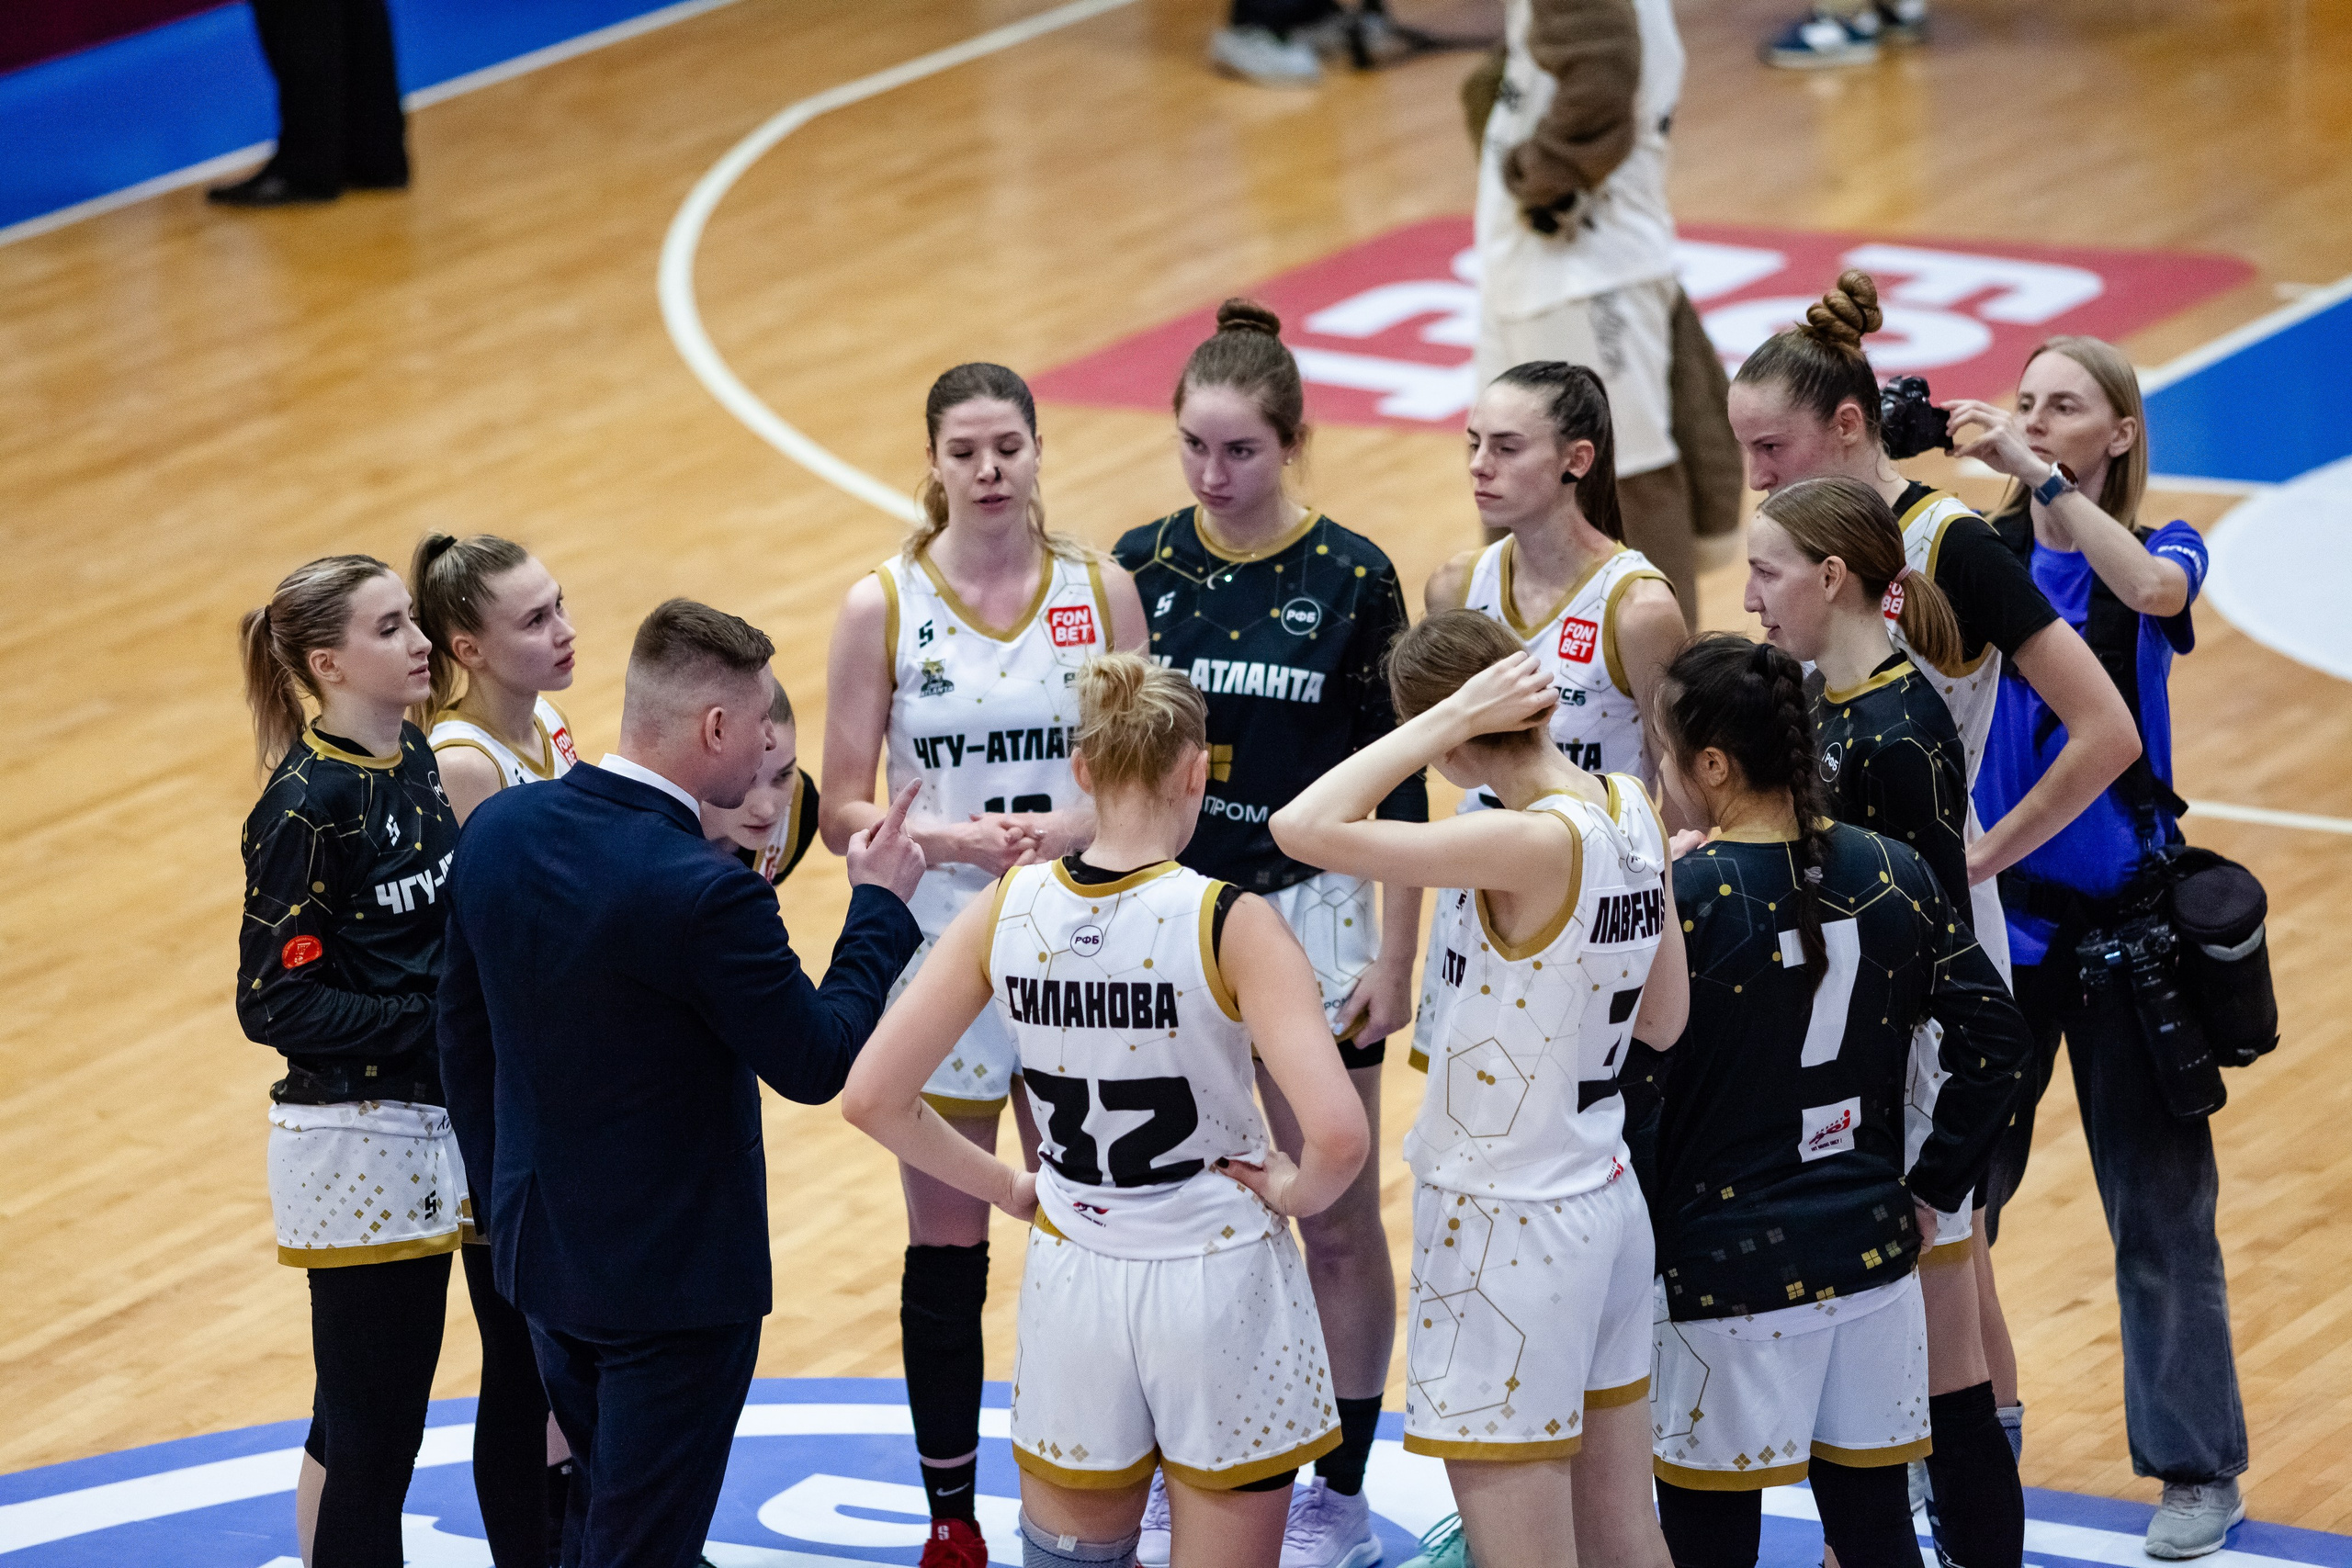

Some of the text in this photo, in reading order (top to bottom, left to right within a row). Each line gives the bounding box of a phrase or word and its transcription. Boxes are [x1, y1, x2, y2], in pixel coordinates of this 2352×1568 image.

[1882, 595, 1905, 615] BE
[1052, 608, 1090, 626] FON
[1286, 609, 1317, 624] РФБ
[1056, 624, 1091, 643] BET
[1563, 621, 1596, 641] FON
[1560, 637, 1593, 658] BET
[1149, 655, 1326, 704] -АТЛАНТА
[1204, 795, 1269, 823] ПРОМ
[1075, 935, 1100, 945] РФБ
[1005, 976, 1179, 1029] СИЛАНОВА
[1778, 918, 1860, 1068] 7
[1022, 1066, 1205, 1189] 32
